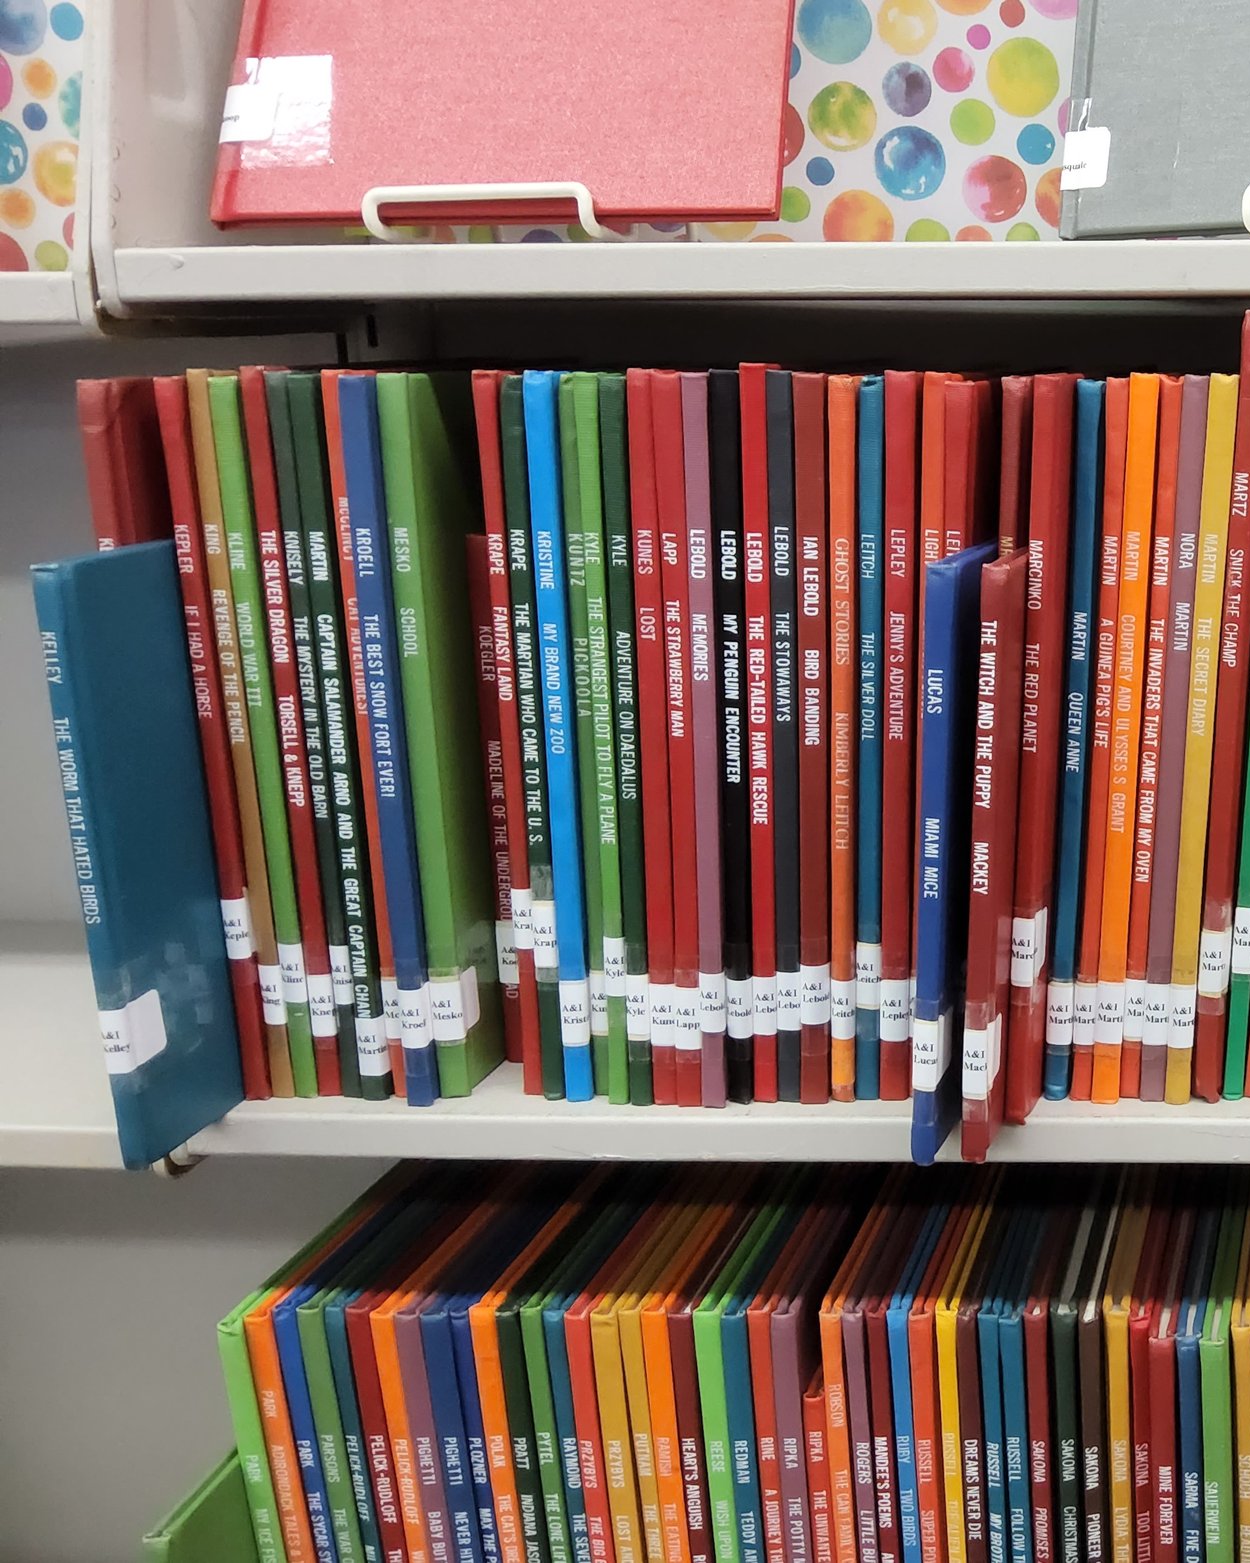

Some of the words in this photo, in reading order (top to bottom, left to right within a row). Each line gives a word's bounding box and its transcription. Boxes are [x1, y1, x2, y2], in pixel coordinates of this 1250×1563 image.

[174, 524, 194, 574] KEPLER
[260, 530, 278, 554] THE
[394, 526, 411, 572] MESKO
[488, 534, 505, 574] KRAPE
[537, 532, 555, 590] KRISTINE
[637, 530, 654, 574] KUNES
[663, 532, 678, 564] LAPP
[690, 528, 706, 578] LEBOLD
[720, 530, 737, 580] LEBOLD
[774, 526, 789, 576] LEBOLD
[803, 536, 818, 560] IAN
[890, 528, 906, 578] LEPLEY
[1179, 532, 1196, 568] NORA
[263, 560, 283, 604] SILVER
[803, 566, 818, 616] LEBOLD
[543, 622, 558, 642] MY
[640, 608, 656, 642] LOST
[665, 600, 680, 622] THE
[722, 614, 738, 634] MY
[775, 612, 790, 636] THE
[1174, 602, 1191, 650] MARTIN
[188, 632, 204, 658] HAD
[268, 608, 289, 662] DRAGON
[400, 608, 417, 658] SCHOOL
[493, 606, 510, 662] FANTASY
[692, 614, 709, 682] MEMORIES
[889, 610, 905, 662] JENNY'S
[981, 620, 997, 646] THE
[1071, 612, 1087, 660] MARTIN
[41, 632, 66, 684] KELLEY
[544, 646, 561, 688] BRAND
[667, 626, 684, 706] STRAWBERRY
[723, 640, 740, 700] PENGUIN
[804, 650, 819, 680] BIRD
[979, 652, 996, 696] WITCH
[193, 678, 212, 718] HORSE
[497, 668, 513, 700] LAND
[775, 640, 792, 722] STOWAWAYS
[927, 668, 943, 714] LUCAS
[277, 696, 297, 748] TORSELL
[547, 694, 563, 722] NEW
[670, 710, 685, 738] MAN
[804, 688, 820, 746] BANDING
[889, 666, 904, 740] ADVENTURE
[978, 700, 995, 730] AND
[1068, 692, 1084, 736] QUEEN
[54, 718, 75, 742] THE
[549, 728, 565, 754] ZOO
[725, 706, 742, 784] ENCOUNTER
[977, 736, 993, 758] THE
[58, 750, 82, 792] WORM
[1066, 740, 1082, 772] ANNE
[284, 766, 303, 808] KNEPP
[976, 766, 993, 808] PUPPY
[65, 798, 87, 832] THAT
[71, 836, 94, 880] HATED
[924, 818, 940, 858] MIAMI
[923, 866, 939, 900] MICE
[973, 842, 990, 896] MACKEY
[78, 884, 101, 924] BIRDS
[802, 982, 821, 990] A&I
[320, 1434, 341, 1484] PARSONS
[416, 1436, 436, 1486] PIGHETTI
[514, 1438, 530, 1470] PRATT
[537, 1432, 554, 1464] PYTEL
[562, 1438, 582, 1488] RAYMOND
[682, 1438, 699, 1482] HEART'S
[734, 1440, 751, 1484] REDMAN
[783, 1438, 800, 1468] RIPKA
[874, 1436, 890, 1490] MANDEE'S
[896, 1436, 912, 1464] RUBY
[964, 1438, 979, 1484] DREAMS
[900, 1488, 915, 1512] TWO
[1158, 1466, 1172, 1492] MINE
[686, 1484, 704, 1530] ANGUISH
[877, 1492, 892, 1528] POEMS
[966, 1486, 981, 1520] NEVER
[1159, 1498, 1173, 1544] FOREVER
[902, 1516, 918, 1546] BIRDS
[968, 1522, 982, 1540] DIE
